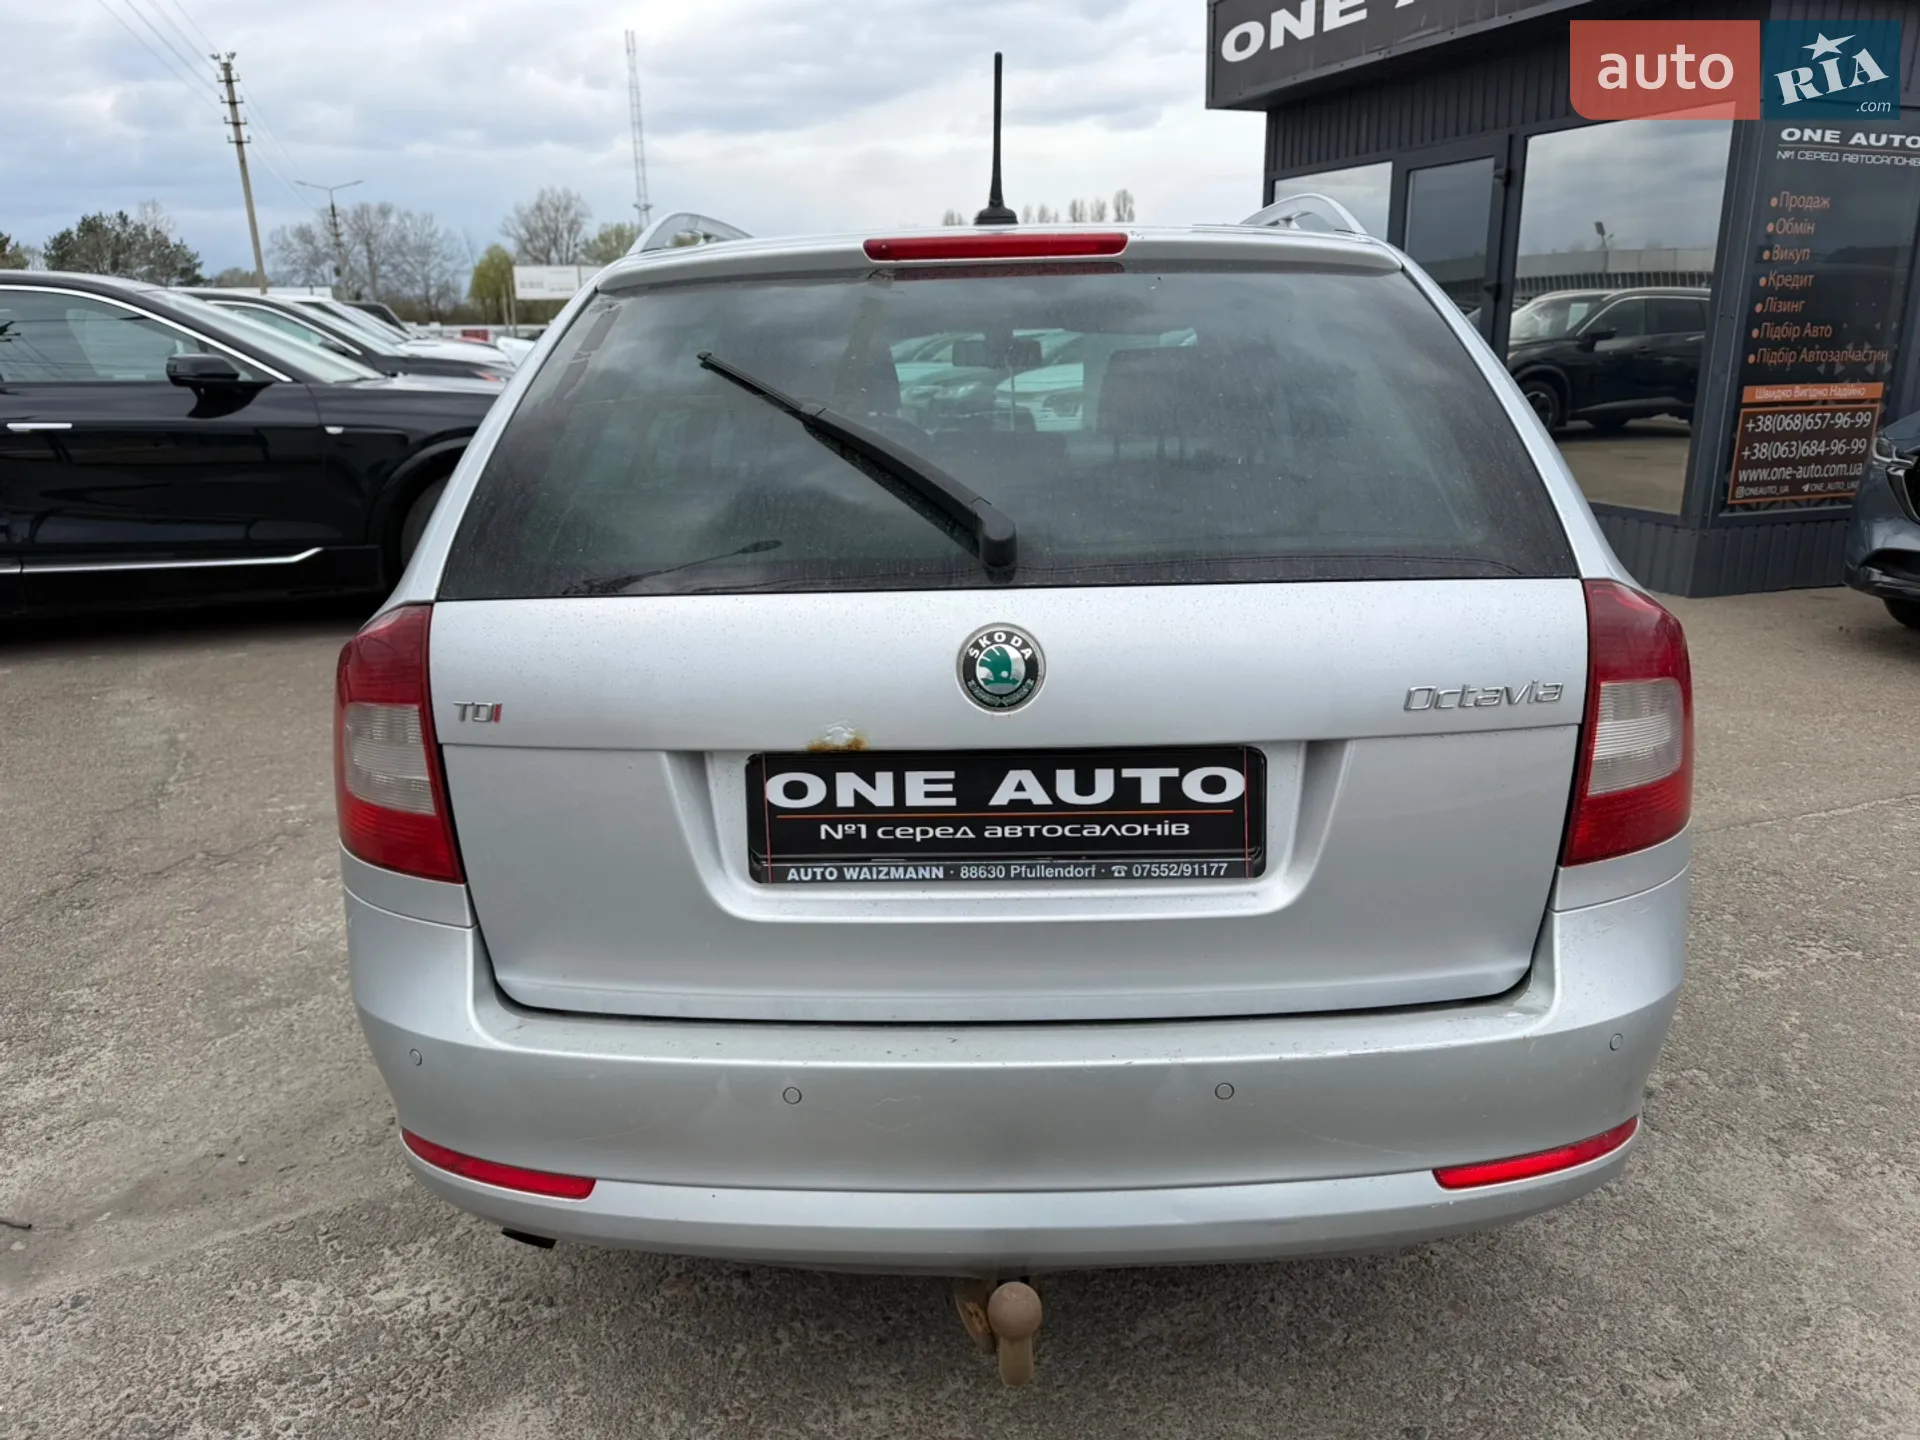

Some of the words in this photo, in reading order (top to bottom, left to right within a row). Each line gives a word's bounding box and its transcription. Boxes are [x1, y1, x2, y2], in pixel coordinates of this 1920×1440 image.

[1221, 0, 1368, 63] ONE
[1780, 127, 1842, 144] ONE
[1848, 132, 1920, 149] AUTO
[1797, 151, 1839, 163] СЕРЕД
[1778, 190, 1831, 212] Продаж
[1775, 217, 1816, 235] Обмін
[1771, 244, 1811, 264] Викуп
[1767, 270, 1815, 290] Кредит
[1763, 296, 1806, 314] Лізинг
[1760, 321, 1801, 342] Підбір
[1802, 321, 1833, 338] Авто
[1756, 346, 1797, 367] Підбір
[1798, 346, 1889, 363] Автозапчастин
[1745, 411, 1872, 433] +38(068)657-96-99
[1741, 438, 1867, 460] +38(063)684-96-99
[1738, 462, 1863, 483] www.one-auto.com.ua
[968, 631, 1033, 660] SKODA
[1403, 680, 1564, 712] Octavia
[766, 771, 957, 810] ONE
[988, 766, 1246, 806] AUTO
[876, 825, 976, 842] серед
[983, 819, 1190, 838] автосалонів
[786, 866, 838, 881] AUTO
[843, 865, 944, 880] WAIZMANN
[959, 864, 1005, 879] 88630
[1010, 863, 1096, 878] Pfullendorf
[1131, 862, 1229, 877] 07552/91177
